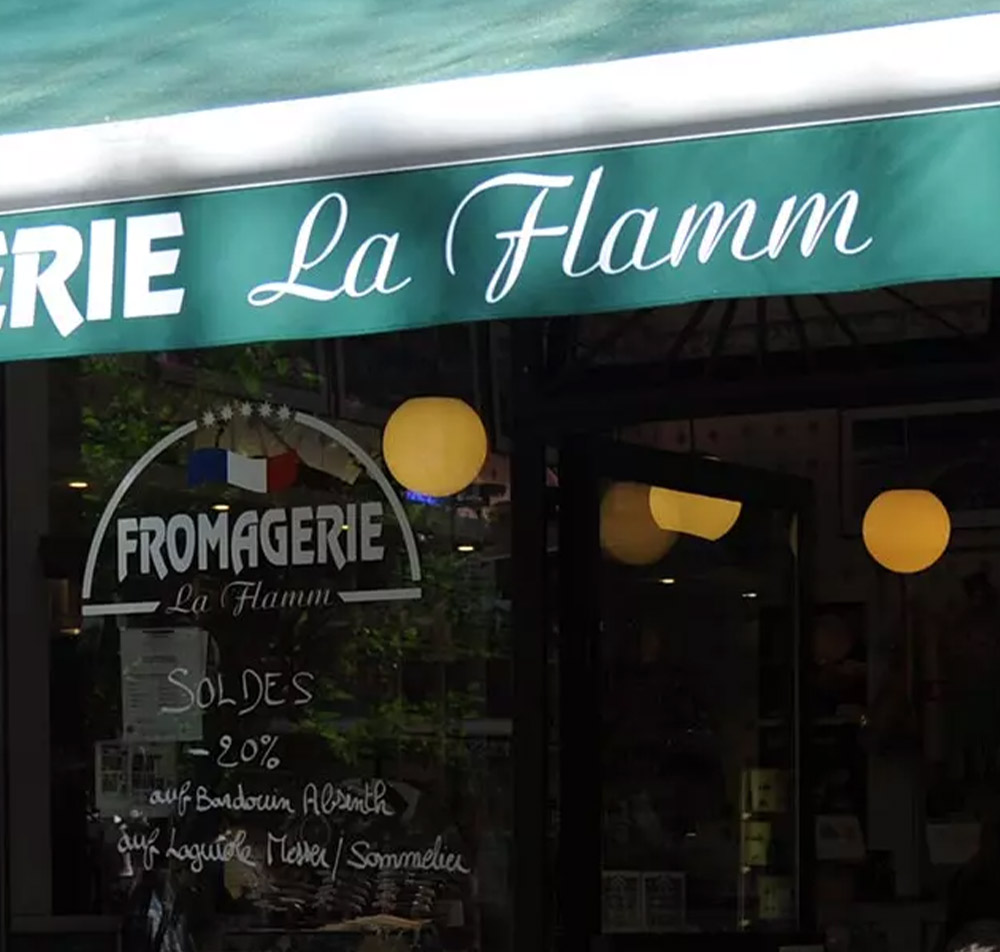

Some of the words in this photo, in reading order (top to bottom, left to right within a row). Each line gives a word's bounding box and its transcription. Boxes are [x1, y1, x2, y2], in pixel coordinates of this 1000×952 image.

[247, 192, 411, 306] La
[445, 166, 872, 303] Flamm
[117, 502, 385, 582] FROMAGERIE
[165, 583, 210, 617] La
[221, 580, 334, 618] Flamm
[161, 668, 315, 716] SOLDES
